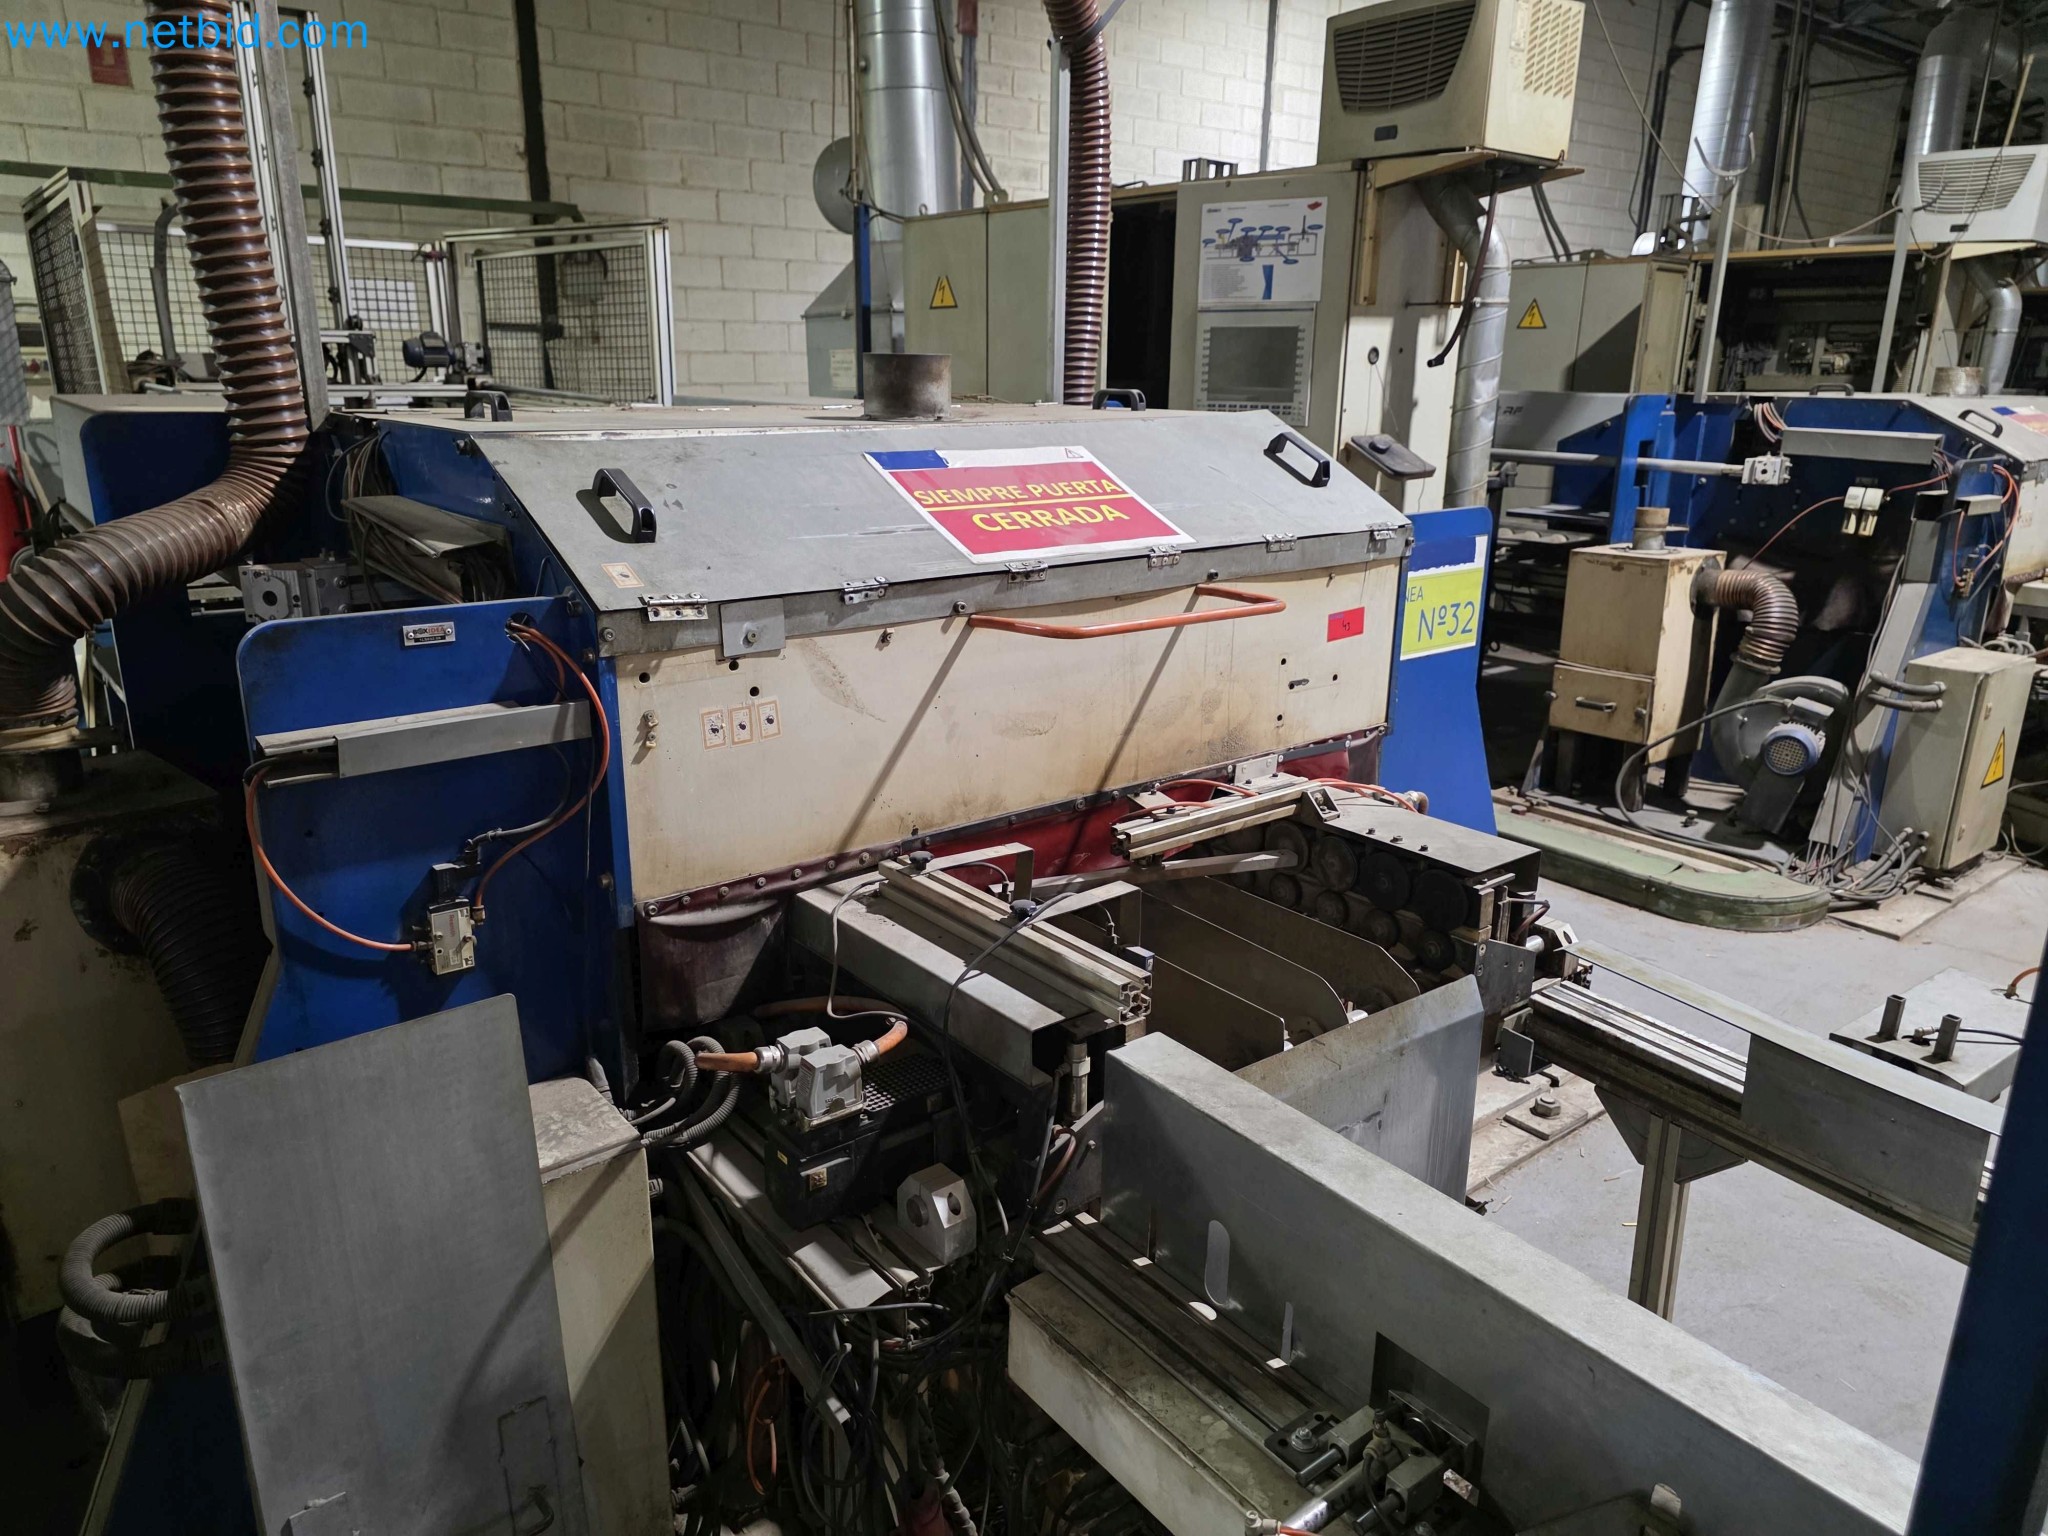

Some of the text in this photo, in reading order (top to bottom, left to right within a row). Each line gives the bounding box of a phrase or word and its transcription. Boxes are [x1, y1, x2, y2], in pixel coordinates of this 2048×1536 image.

[914, 478, 1122, 506] SIEMPRE PUERTA
[971, 503, 1130, 533] CERRADA
